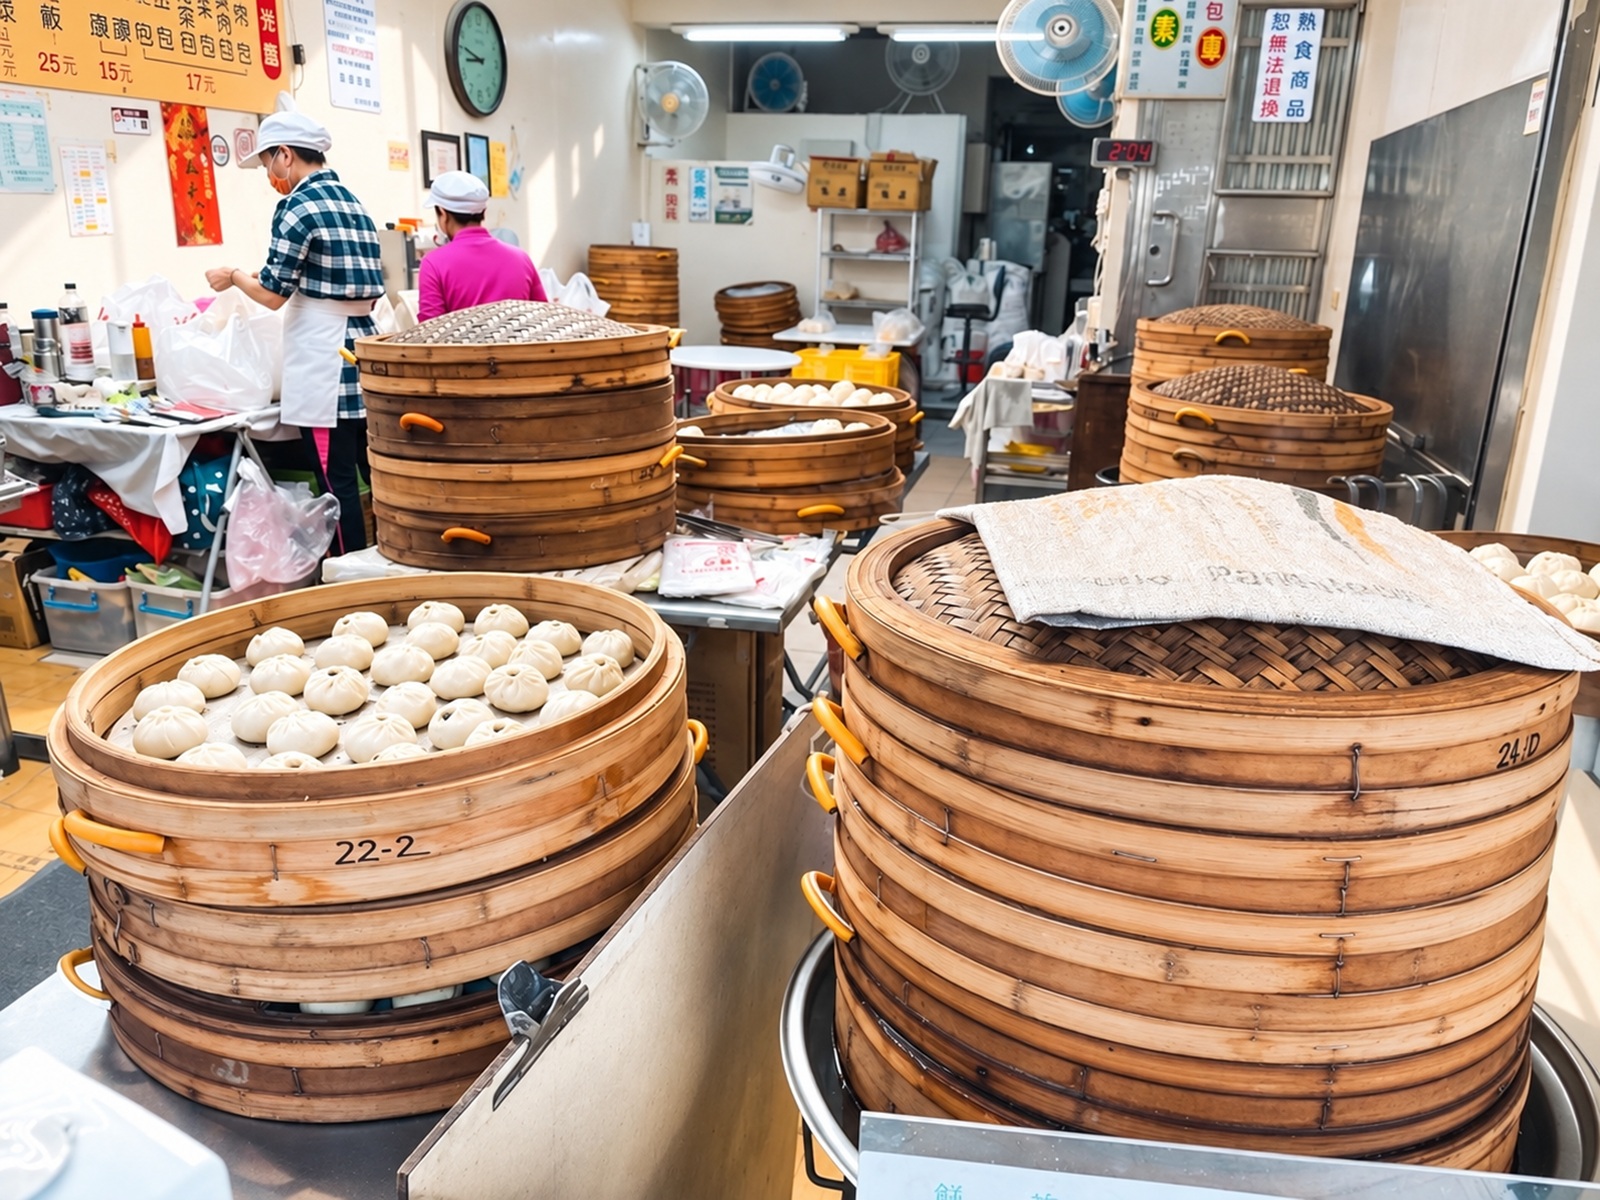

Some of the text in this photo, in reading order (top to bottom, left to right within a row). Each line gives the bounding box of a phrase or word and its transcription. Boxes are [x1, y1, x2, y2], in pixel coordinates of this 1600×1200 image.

[1153, 14, 1176, 43] 素
[38, 51, 78, 76] 25元
[98, 60, 133, 83] 15元
[186, 72, 216, 94] 17元
[335, 834, 431, 866] 22-2
